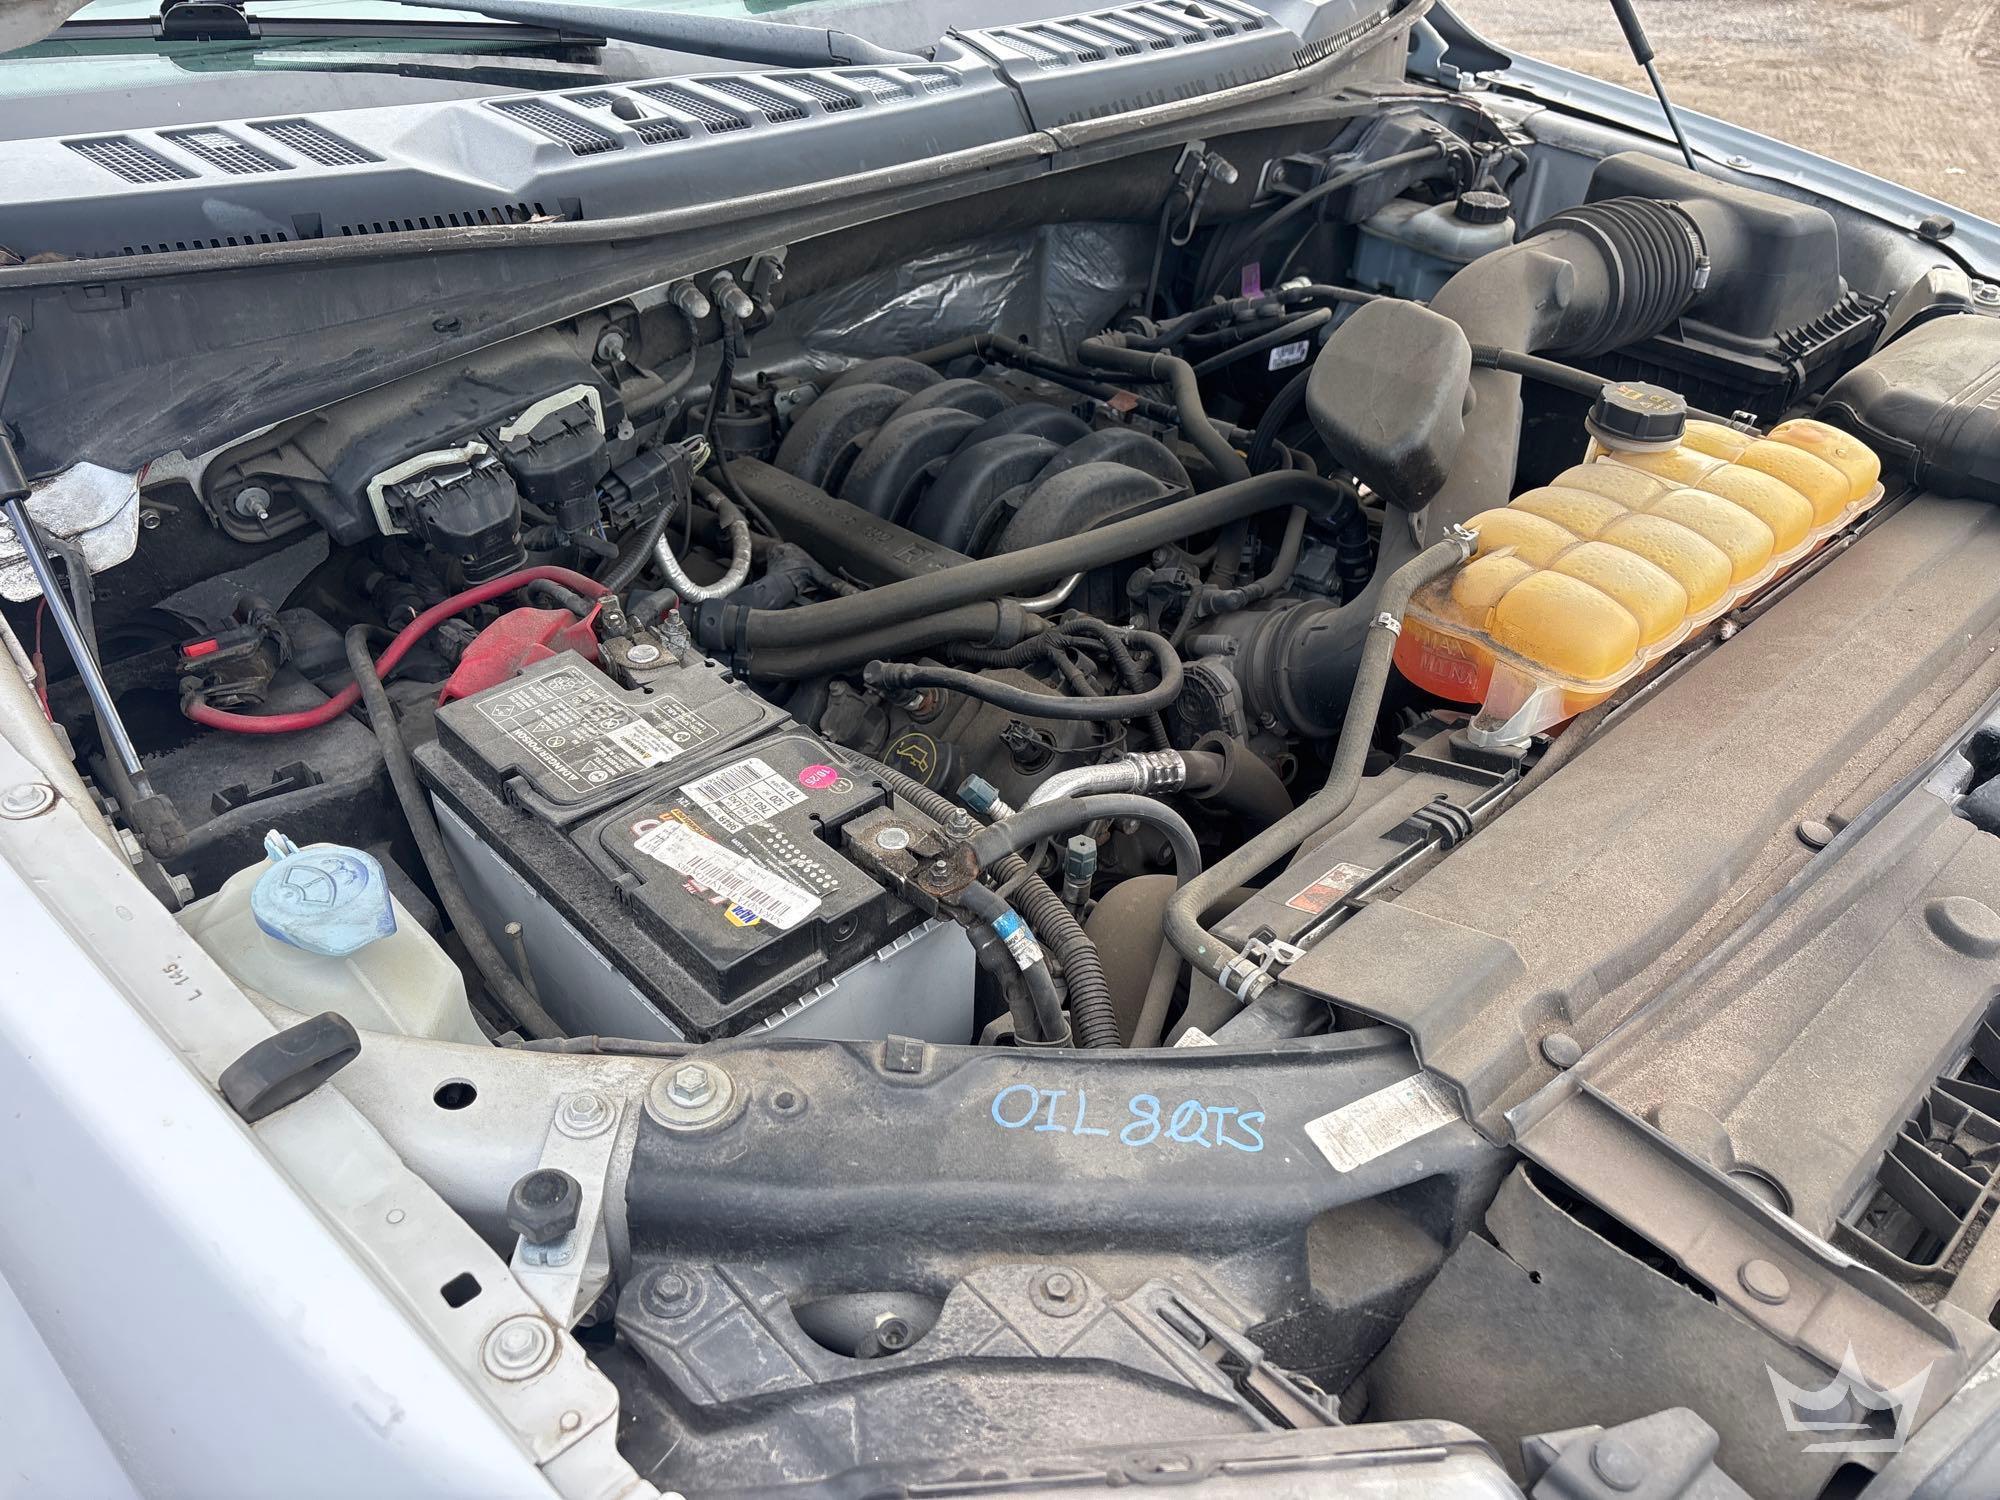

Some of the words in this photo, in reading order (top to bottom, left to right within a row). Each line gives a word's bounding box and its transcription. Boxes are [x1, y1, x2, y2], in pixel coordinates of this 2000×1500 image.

[511, 728, 573, 776] DANGER/POISON
[804, 768, 831, 786] 10/25
[768, 794, 785, 806] 120
[785, 790, 799, 799] 70
[753, 801, 772, 813] 760
[732, 906, 759, 923] NAPA
[991, 1083, 1110, 1137] OIL
